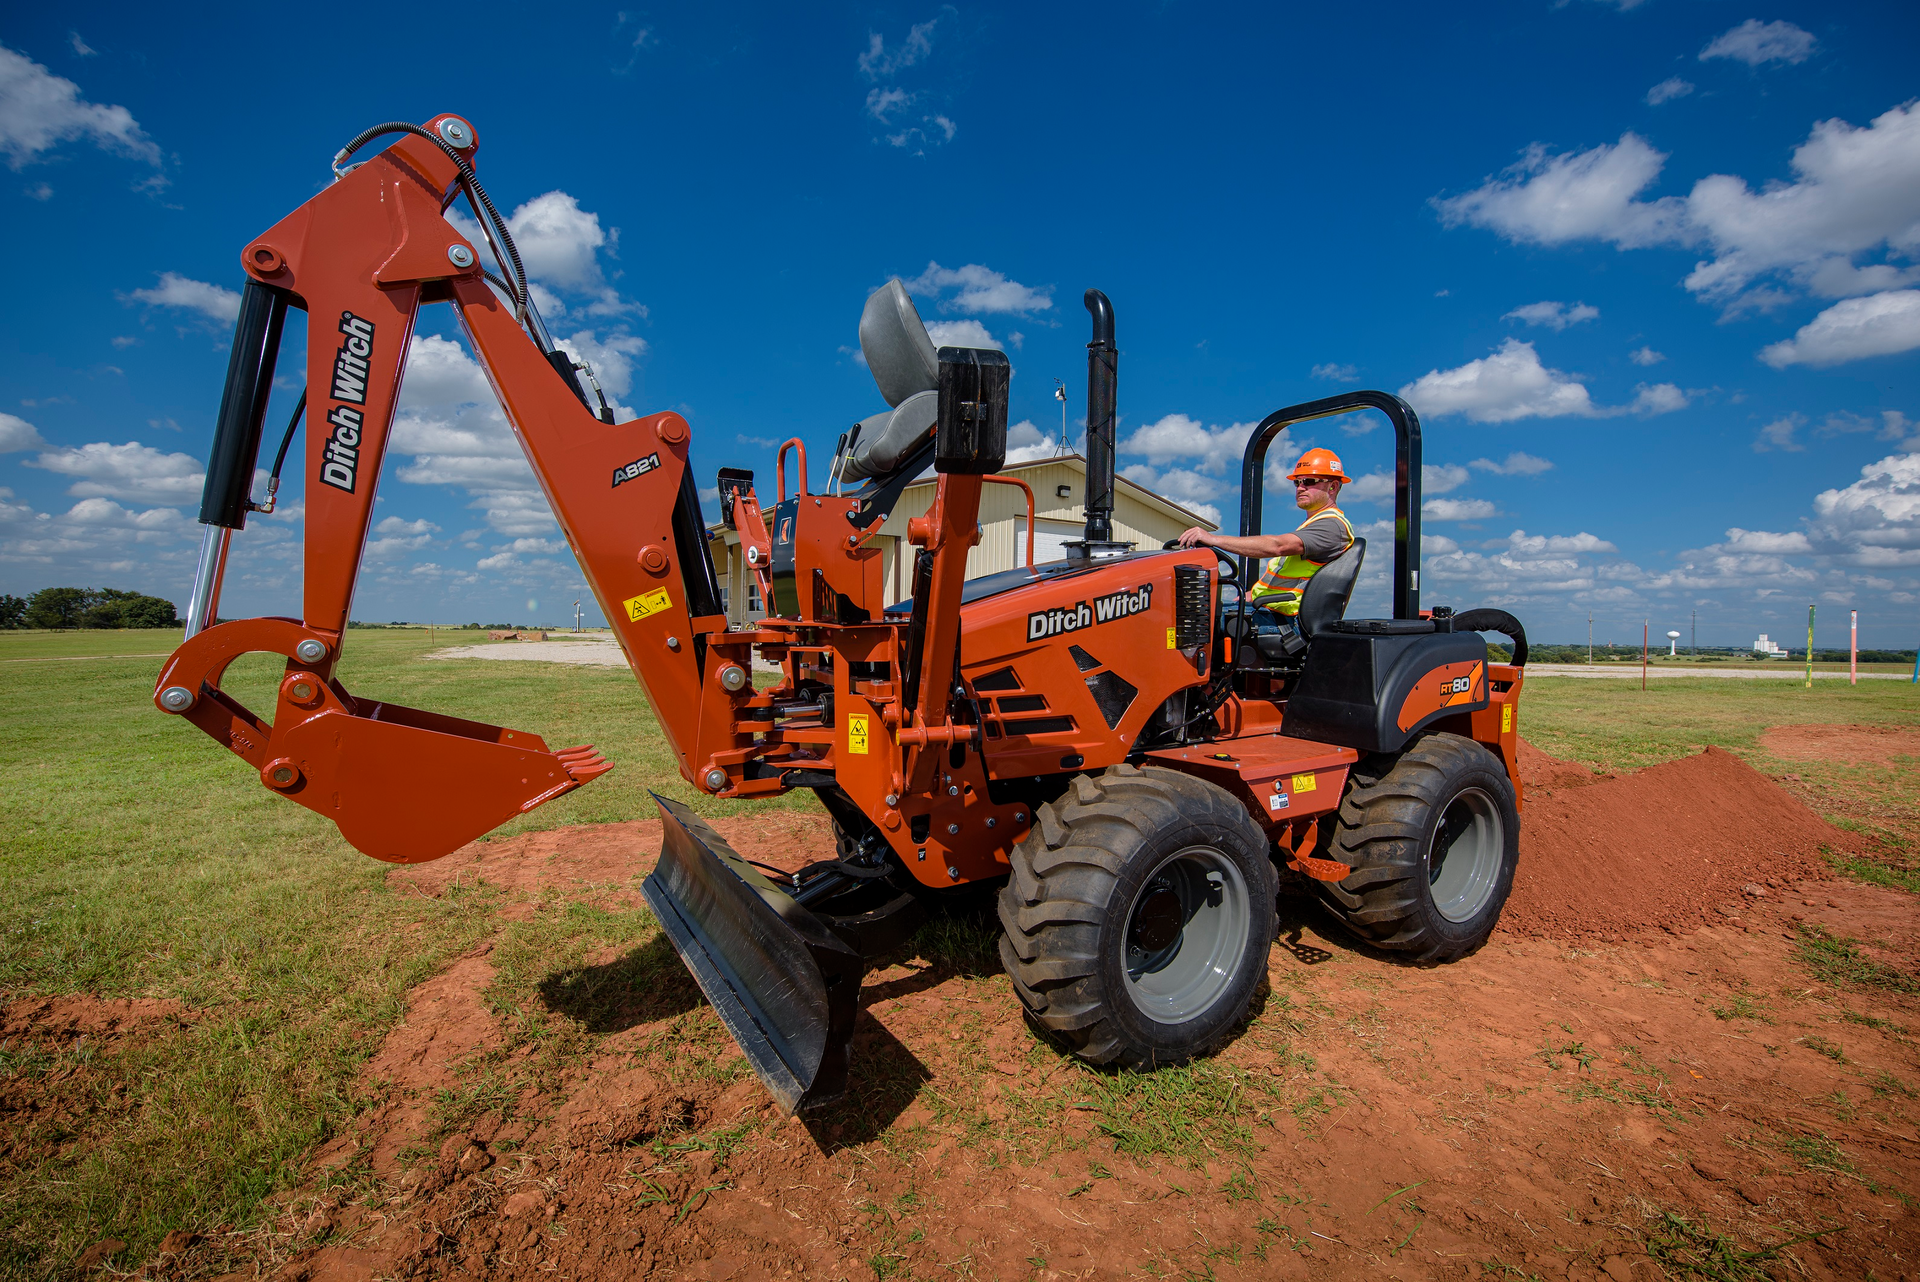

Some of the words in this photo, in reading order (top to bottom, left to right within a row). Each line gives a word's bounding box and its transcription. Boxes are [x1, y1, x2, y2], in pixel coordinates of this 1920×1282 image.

[333, 316, 373, 403] Witch
[322, 405, 362, 491] Ditch
[613, 453, 660, 486] A821
[1029, 604, 1091, 640] Ditch
[1095, 588, 1150, 622] Witch
[1440, 676, 1470, 694] RT80
